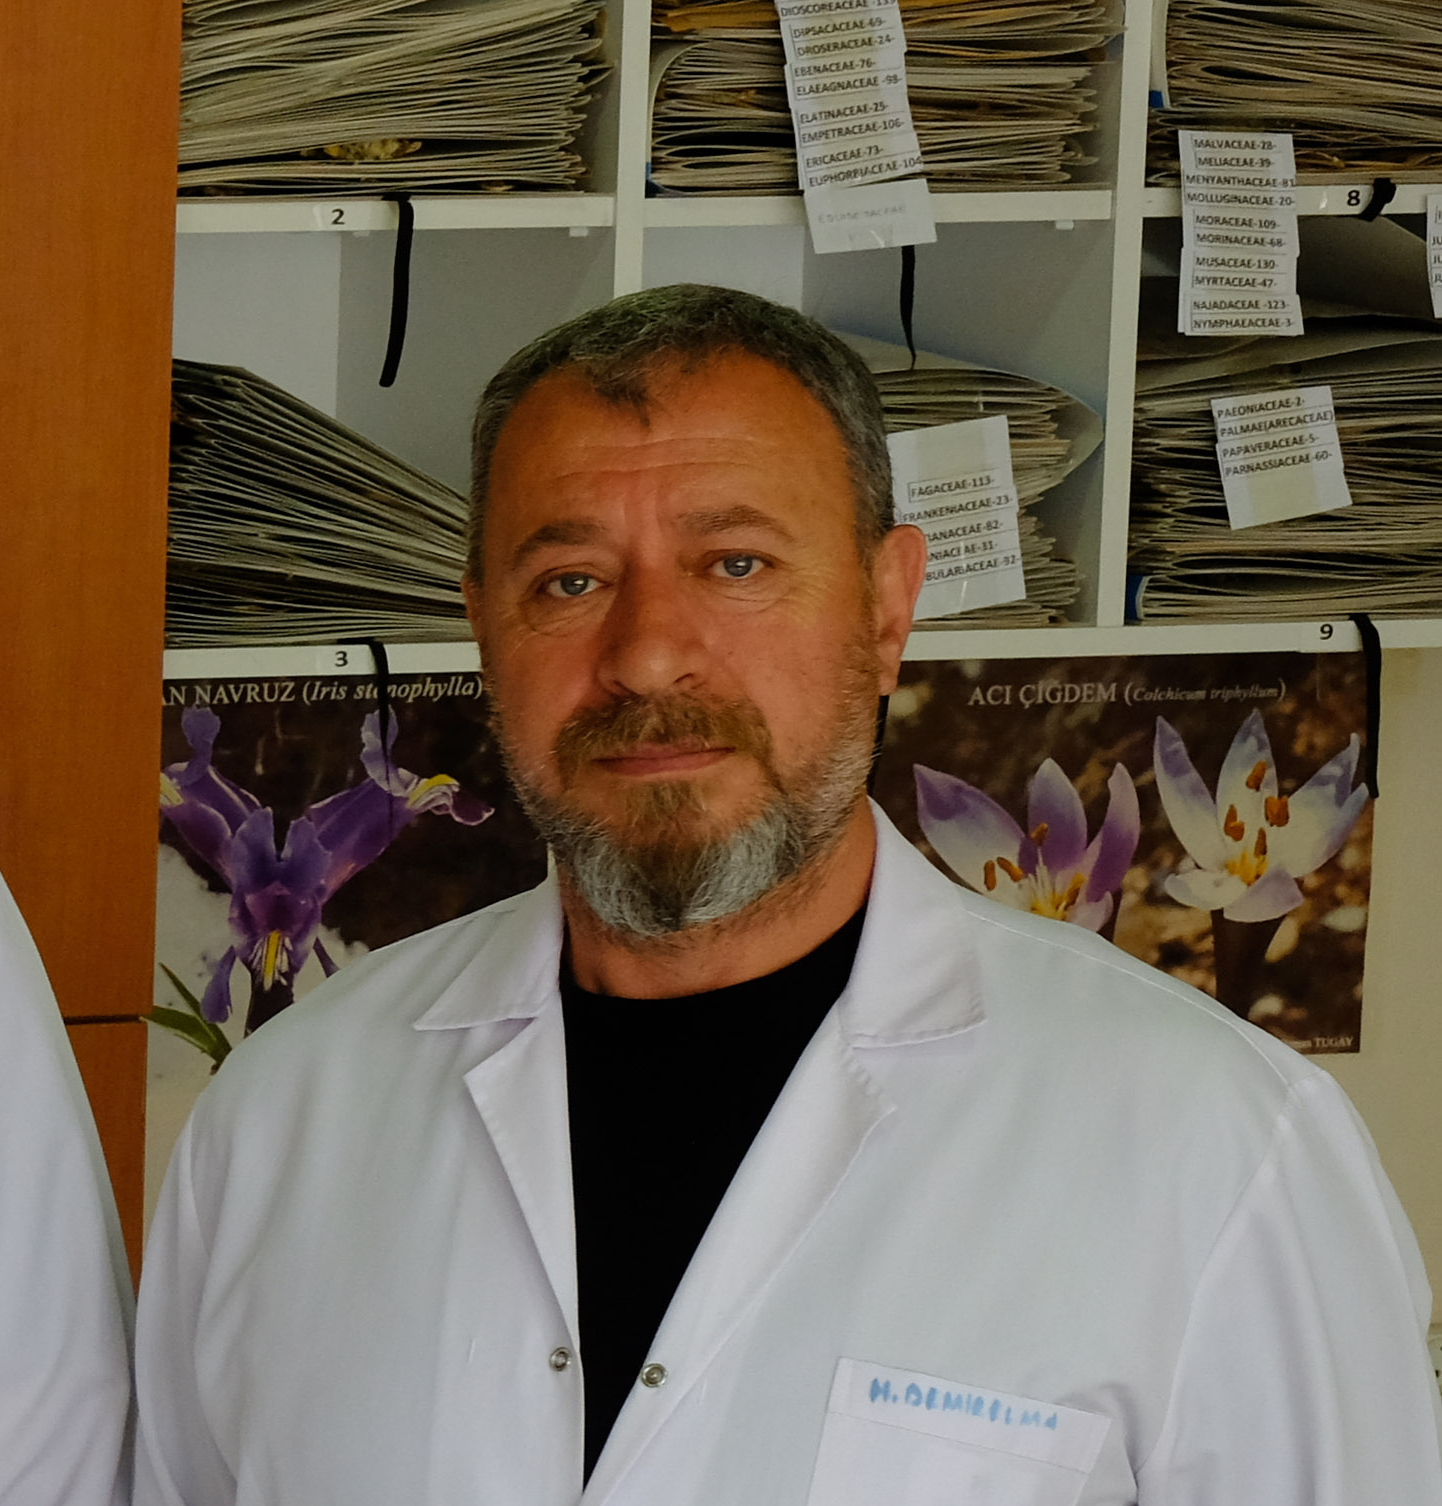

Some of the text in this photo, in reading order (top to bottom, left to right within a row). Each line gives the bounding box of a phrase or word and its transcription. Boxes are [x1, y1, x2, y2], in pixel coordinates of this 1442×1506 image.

[1347, 190, 1360, 206] 8
[331, 208, 346, 225] 2
[1319, 623, 1334, 640] 9
[334, 651, 348, 667] 3
[194, 682, 296, 704] NAVRUZ
[302, 681, 348, 705] (Iris
[967, 685, 1012, 705] ACI
